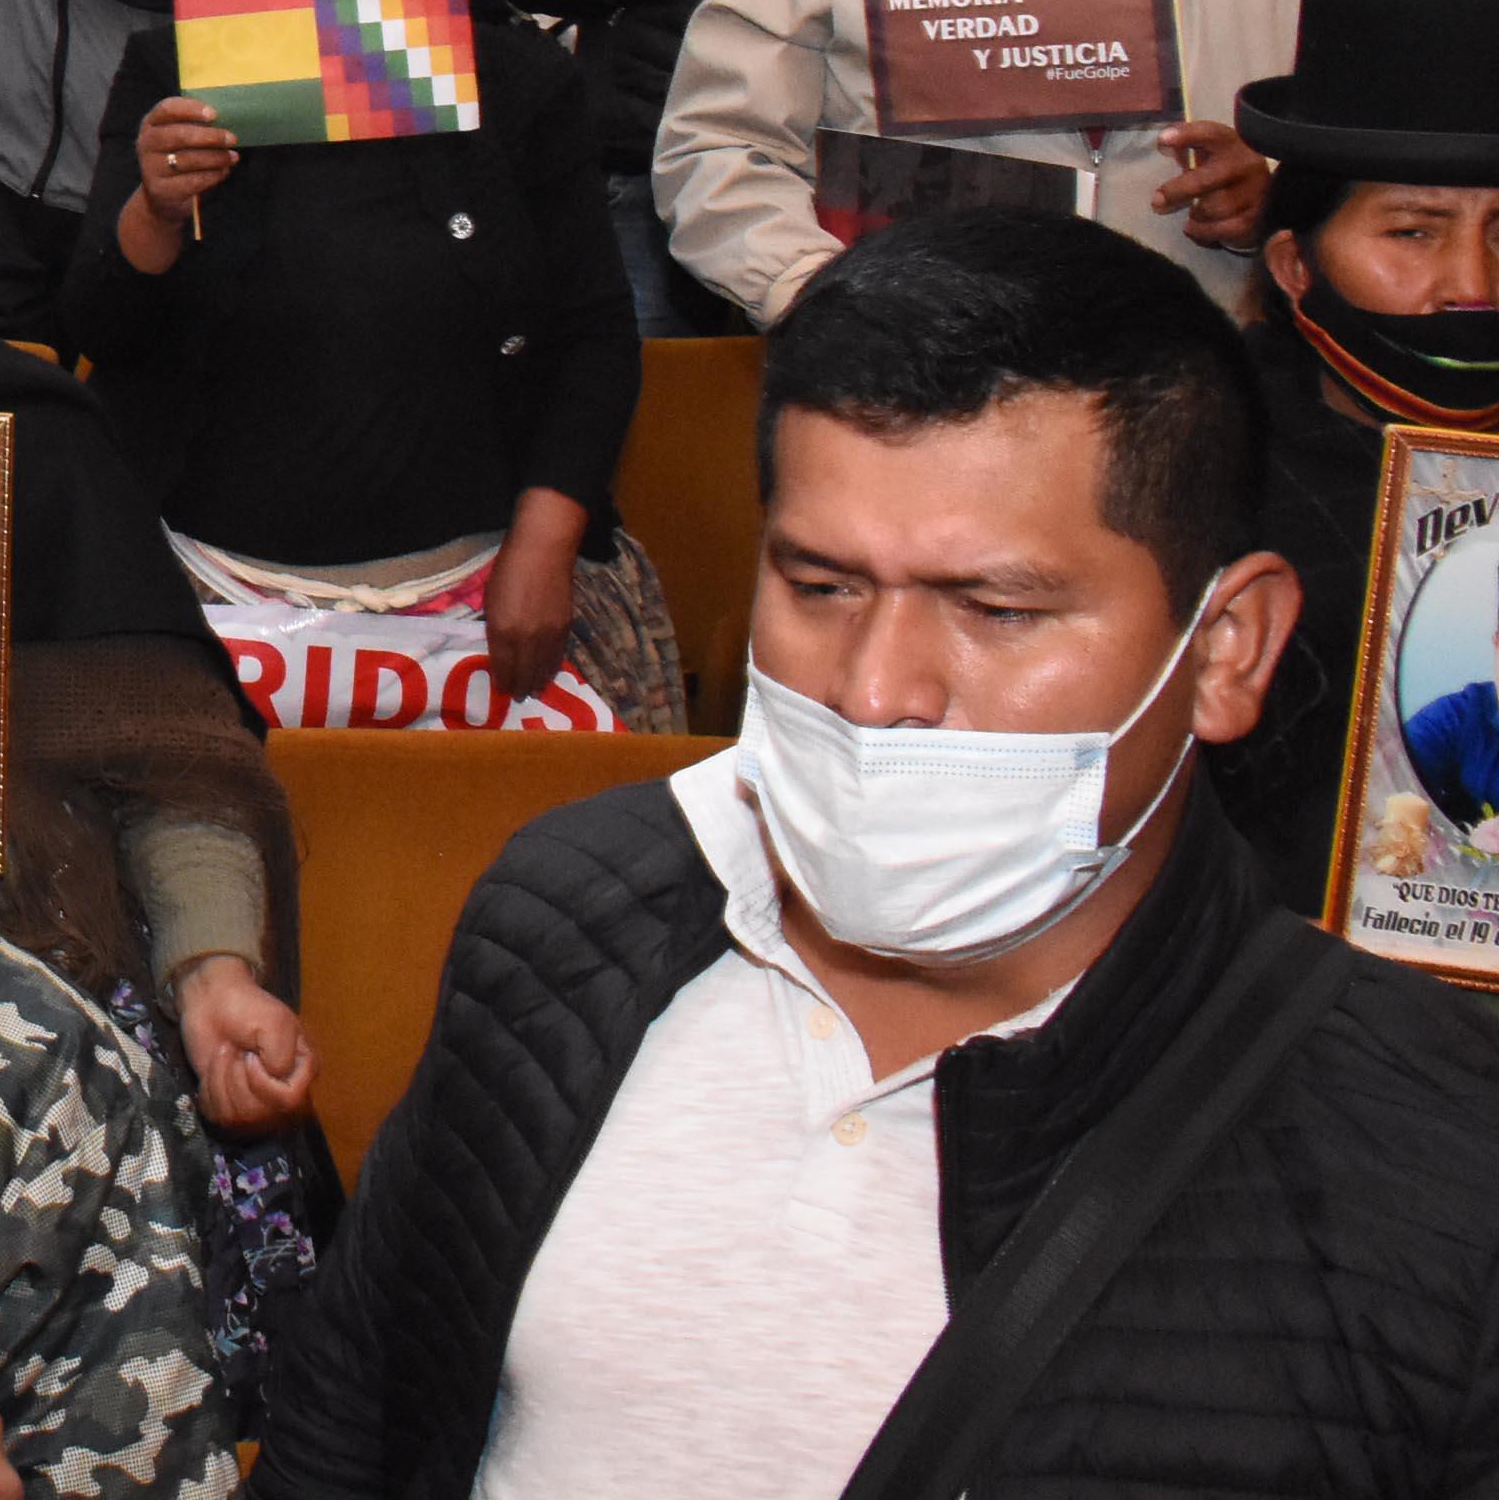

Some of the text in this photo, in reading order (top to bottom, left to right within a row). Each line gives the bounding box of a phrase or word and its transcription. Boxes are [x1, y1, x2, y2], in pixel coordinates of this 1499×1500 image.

[922, 14, 1039, 41] VERDAD
[972, 41, 1128, 70] Y JUSTICIA
[1046, 64, 1130, 81] #FueGolpe
[1438, 886, 1479, 908] DIOS
[1362, 906, 1441, 938] Fallecio
[1445, 921, 1466, 941] el
[1469, 921, 1491, 944] 19
